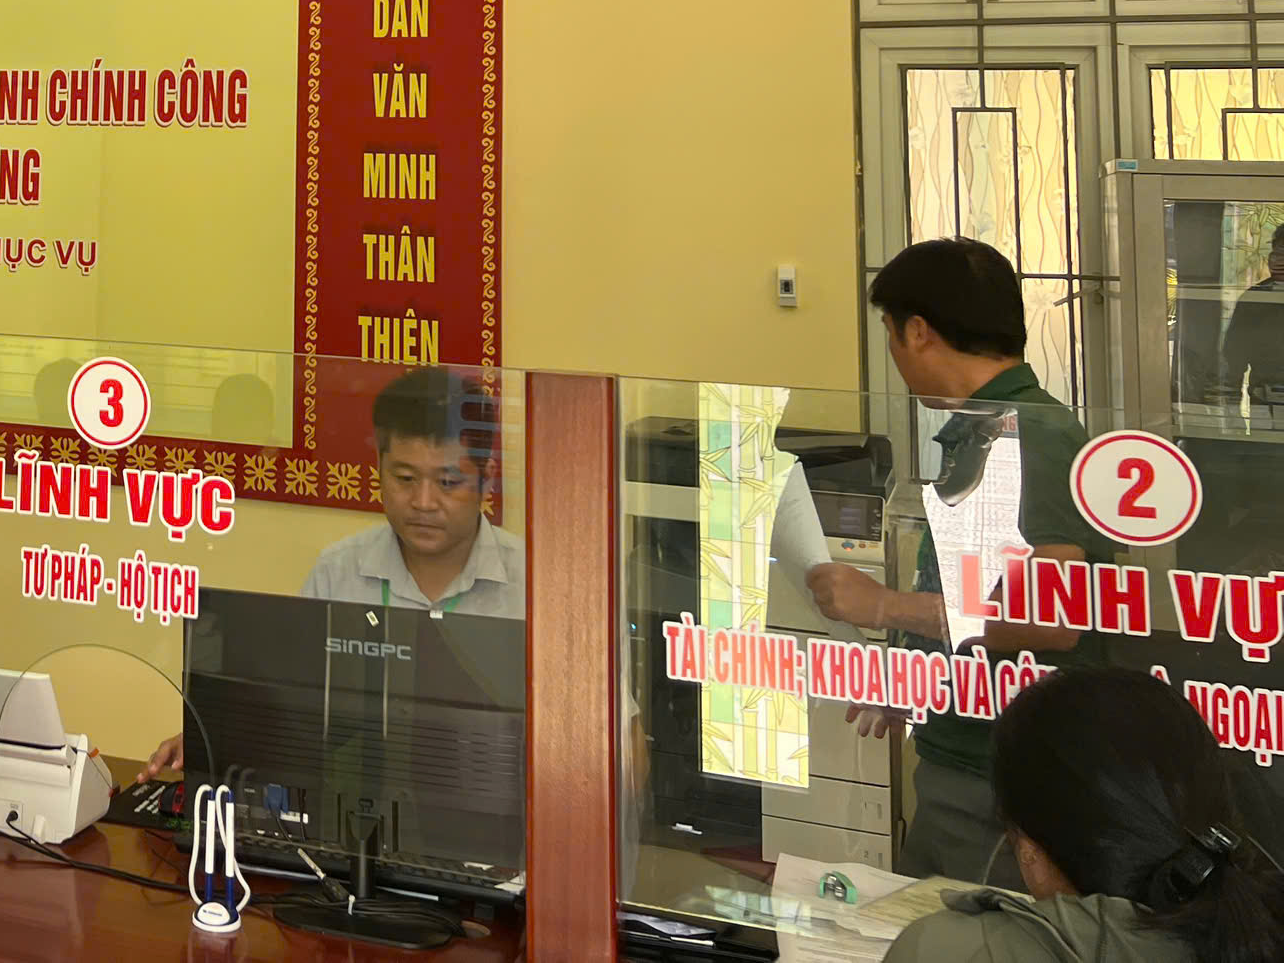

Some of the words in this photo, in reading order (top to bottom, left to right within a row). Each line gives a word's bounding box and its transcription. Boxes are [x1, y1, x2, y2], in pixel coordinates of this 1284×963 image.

[45, 58, 147, 127] CHÍNH
[153, 58, 249, 128] CÔNG
[373, 63, 427, 118] VĂN
[363, 152, 436, 200] MINH
[55, 239, 98, 276] VỤ
[363, 225, 435, 283] THÂN
[98, 378, 124, 428] 3
[124, 469, 235, 541] VỰC
[1115, 456, 1158, 520] 2
[21, 544, 49, 597] TƯ
[49, 543, 103, 604] PHÁP
[118, 550, 148, 622] HỘ
[150, 563, 200, 626] TỊCH
[957, 541, 1151, 637] LĨNH
[663, 612, 708, 683] TÀI
[713, 619, 806, 701] CHÍNH;
[807, 638, 888, 707] KHOA
[888, 646, 952, 725] HỌC
[951, 645, 996, 720] VÀ
